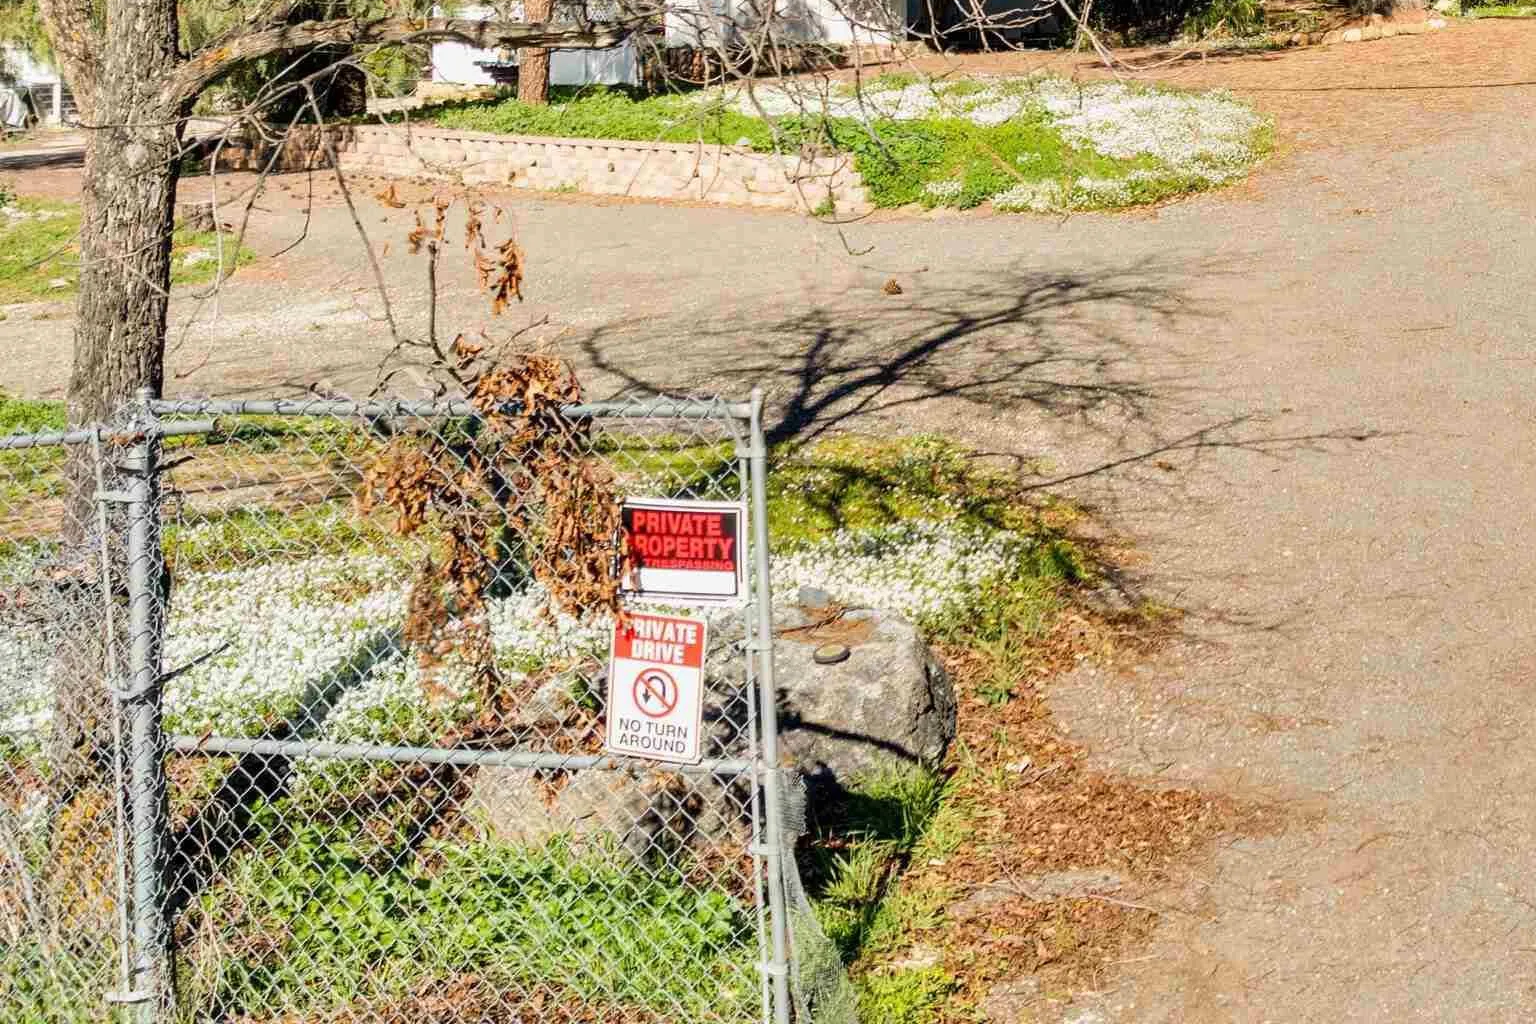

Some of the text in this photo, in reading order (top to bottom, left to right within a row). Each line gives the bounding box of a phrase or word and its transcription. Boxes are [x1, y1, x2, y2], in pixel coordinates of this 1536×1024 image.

[633, 511, 721, 536] PRIVATE
[628, 534, 733, 560] ROPERTY
[632, 639, 685, 664] DRIVE
[619, 718, 688, 739] NO TURN
[619, 733, 686, 753] AROUND
